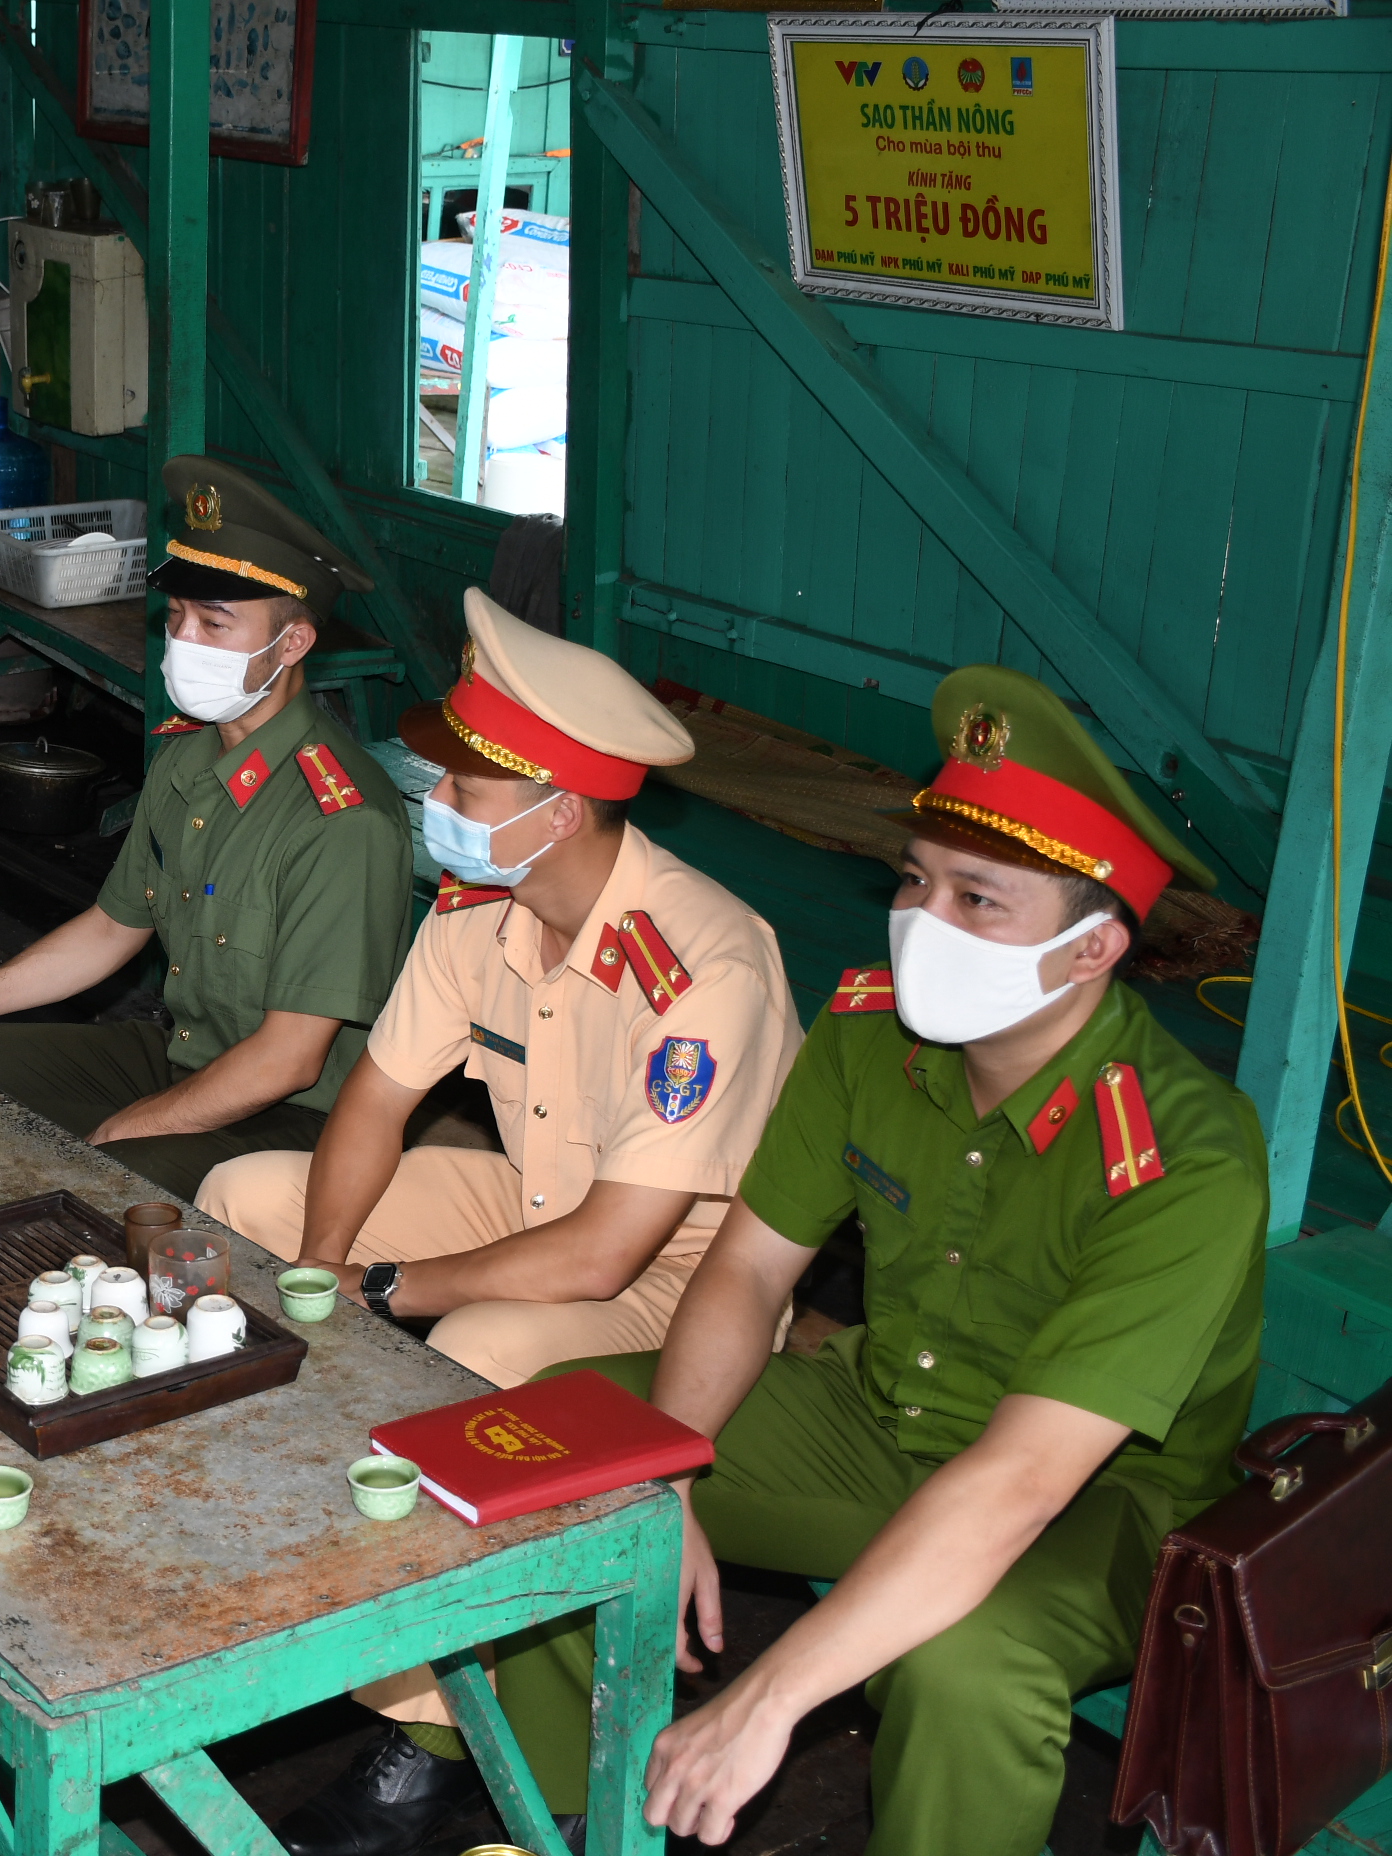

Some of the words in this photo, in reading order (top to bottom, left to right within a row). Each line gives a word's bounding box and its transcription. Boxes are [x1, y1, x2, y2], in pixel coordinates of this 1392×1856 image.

[834, 60, 883, 87] VTV
[860, 103, 896, 128] SAO
[899, 98, 952, 132] THẦN
[957, 103, 1015, 136] NÔNG
[876, 135, 906, 153] Cho
[909, 138, 943, 156] mùa
[947, 139, 971, 158] bội
[975, 141, 1002, 159] thu
[908, 168, 937, 189] KÍNH
[940, 171, 972, 193] TẶNG
[844, 195, 859, 227] 5
[865, 193, 950, 243] TRIỆU
[959, 195, 1048, 245] ĐỒNG
[815, 248, 835, 264] ĐẠM
[837, 250, 858, 266] PHÚ
[860, 250, 876, 267] MỸ
[880, 255, 900, 269] NPK
[902, 255, 924, 272] PHÚ
[926, 257, 943, 273] MỸ
[948, 262, 969, 277] KALI
[972, 263, 996, 280] PHÚ
[998, 265, 1016, 282] MỸ
[1021, 270, 1042, 285] DAP
[1045, 271, 1069, 288] PHÚ
[1072, 272, 1091, 290] MỸ
[652, 1080, 703, 1097] CSGT
